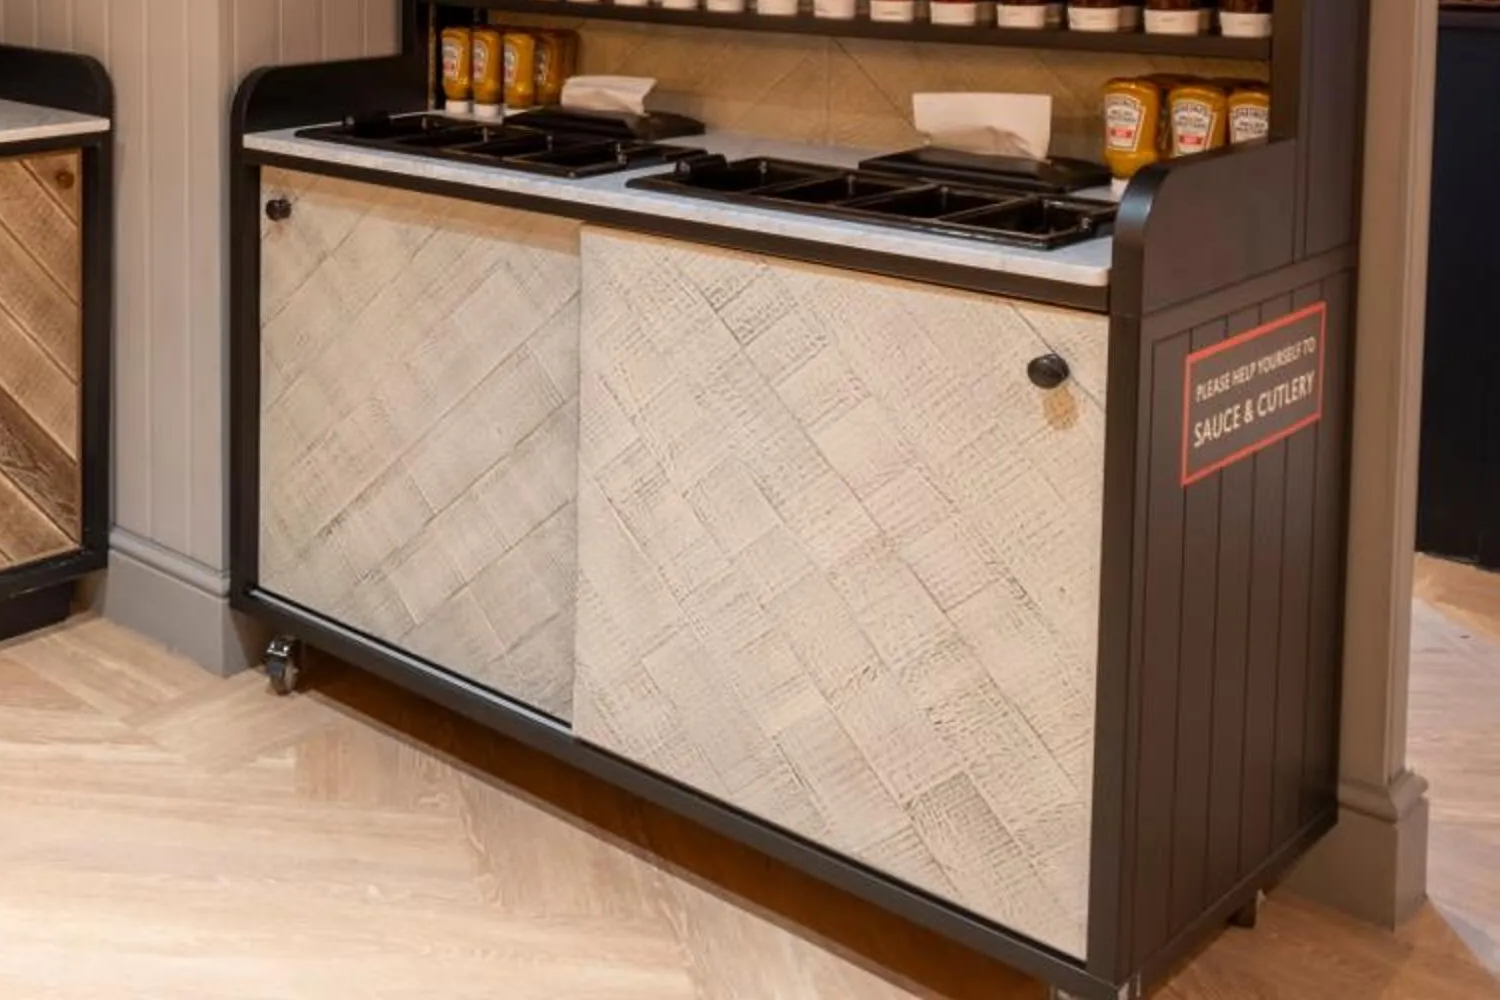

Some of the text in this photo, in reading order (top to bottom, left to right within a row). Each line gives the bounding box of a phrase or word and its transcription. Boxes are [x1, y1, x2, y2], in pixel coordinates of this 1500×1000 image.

[1196, 336, 1317, 403] PLEASE HELP YOURSELF TO
[1194, 370, 1316, 448] SAUCE & CUTLERY
